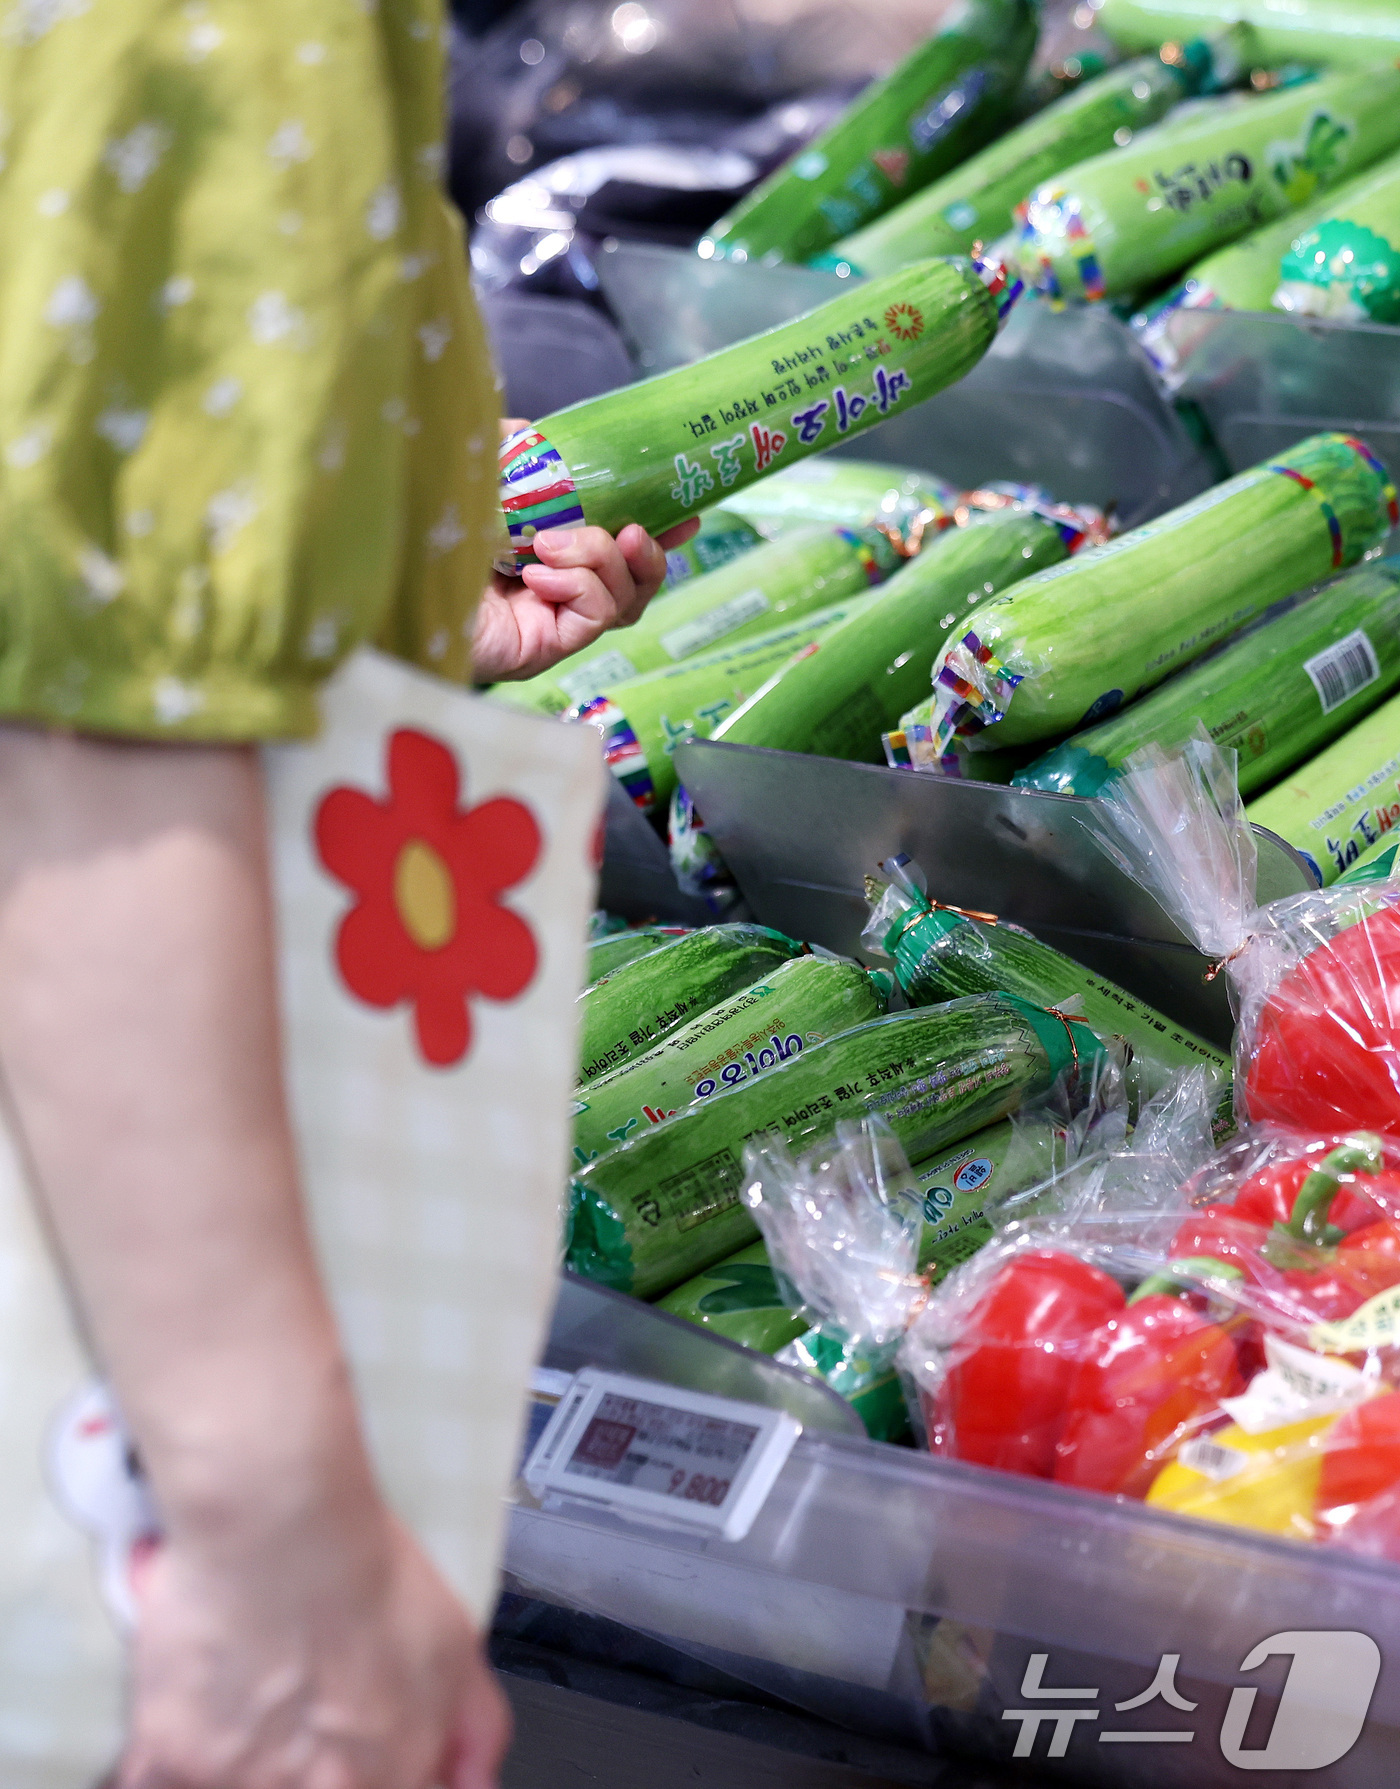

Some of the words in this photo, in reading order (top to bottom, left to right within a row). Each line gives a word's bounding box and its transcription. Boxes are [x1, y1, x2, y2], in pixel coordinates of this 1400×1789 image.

[770, 346, 823, 376] 나라사랑
[802, 366, 831, 390] 살아
[760, 380, 802, 409] 있으며
[719, 397, 760, 426] 저장이
[682, 413, 717, 439] 길다.
[627, 1023, 655, 1047] 가열
[1141, 1012, 1167, 1034] 가열
[1170, 1032, 1225, 1067] 조리하여
[581, 1040, 630, 1079] 조리하여
[833, 1080, 862, 1102] 가열
[781, 1095, 832, 1126] 조리하여
[950, 1149, 974, 1163] GREEN
[961, 1164, 986, 1185] 웰빙
